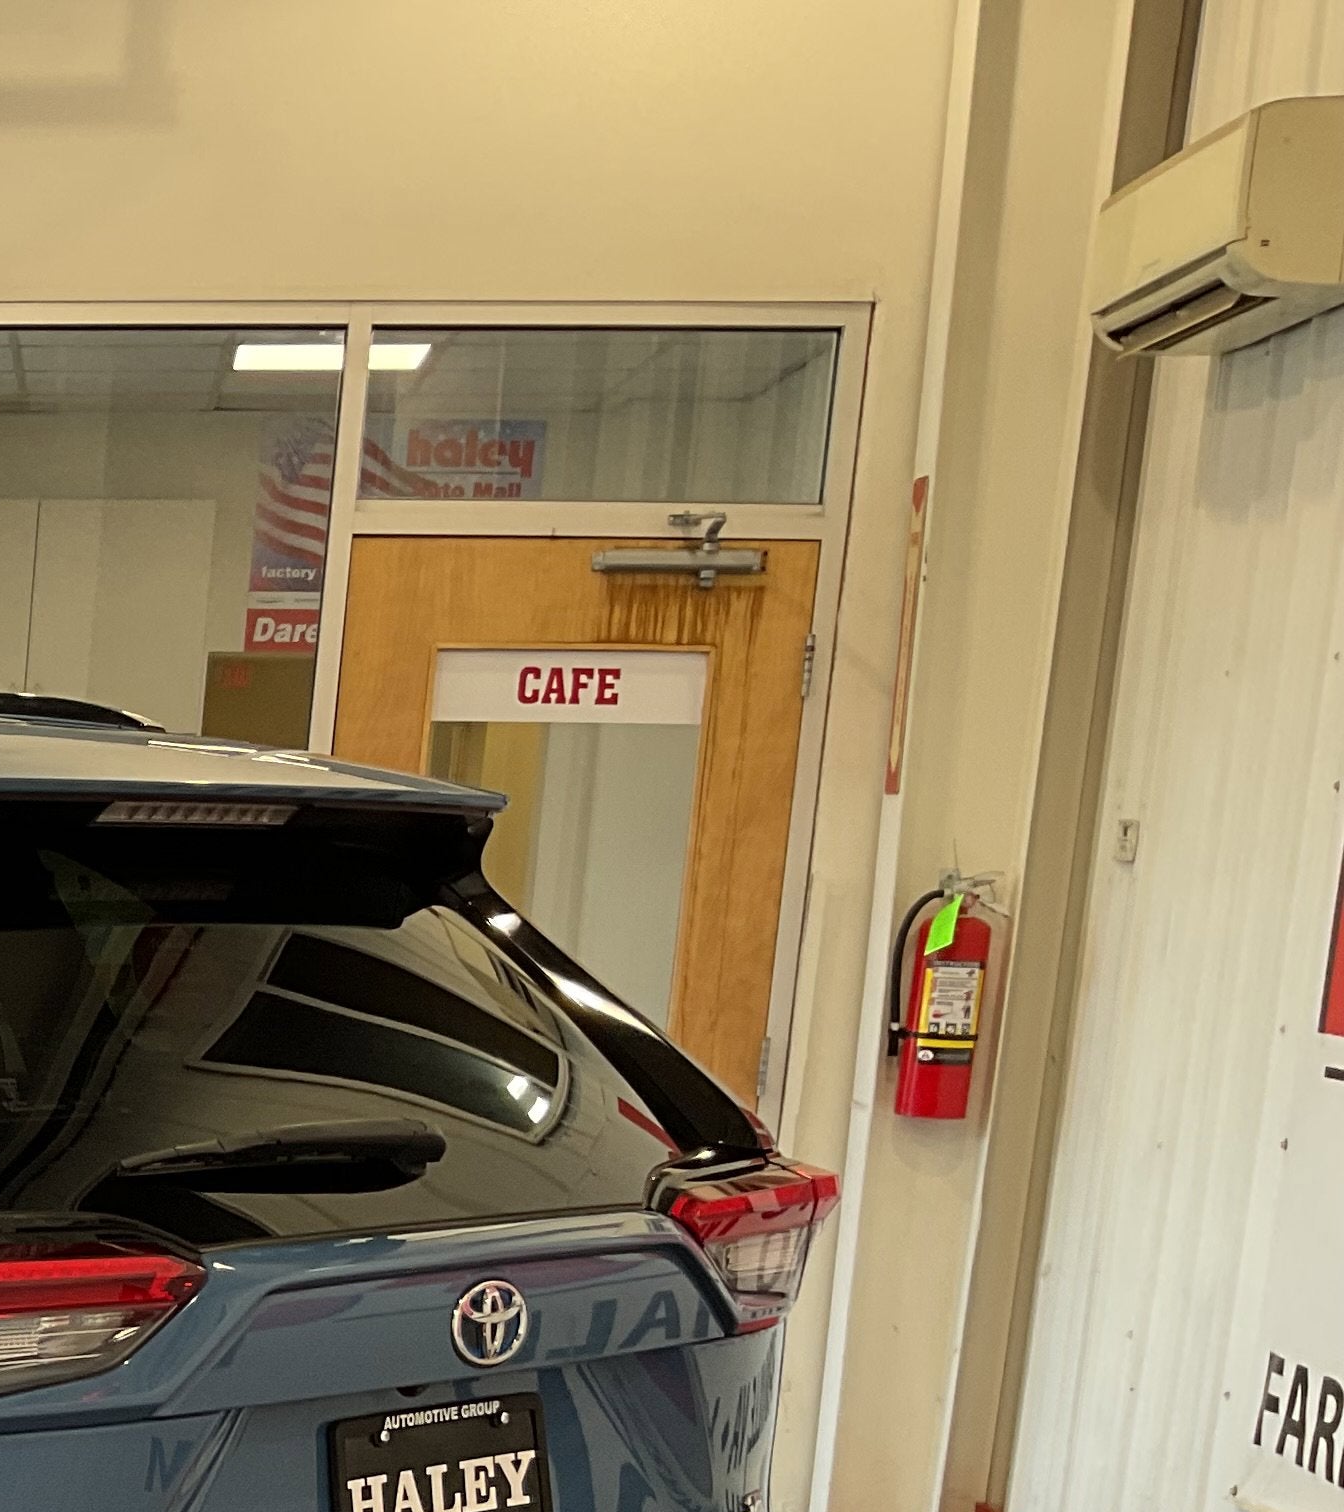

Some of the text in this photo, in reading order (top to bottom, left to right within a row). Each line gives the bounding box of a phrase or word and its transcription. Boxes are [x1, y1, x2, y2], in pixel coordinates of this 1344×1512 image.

[406, 429, 535, 479] haley
[262, 566, 316, 580] factory
[252, 616, 319, 643] Dare
[517, 666, 621, 705] CAFE
[383, 1400, 500, 1430] AUTOMOTIVE GROUP
[1253, 1351, 1344, 1490] FAR
